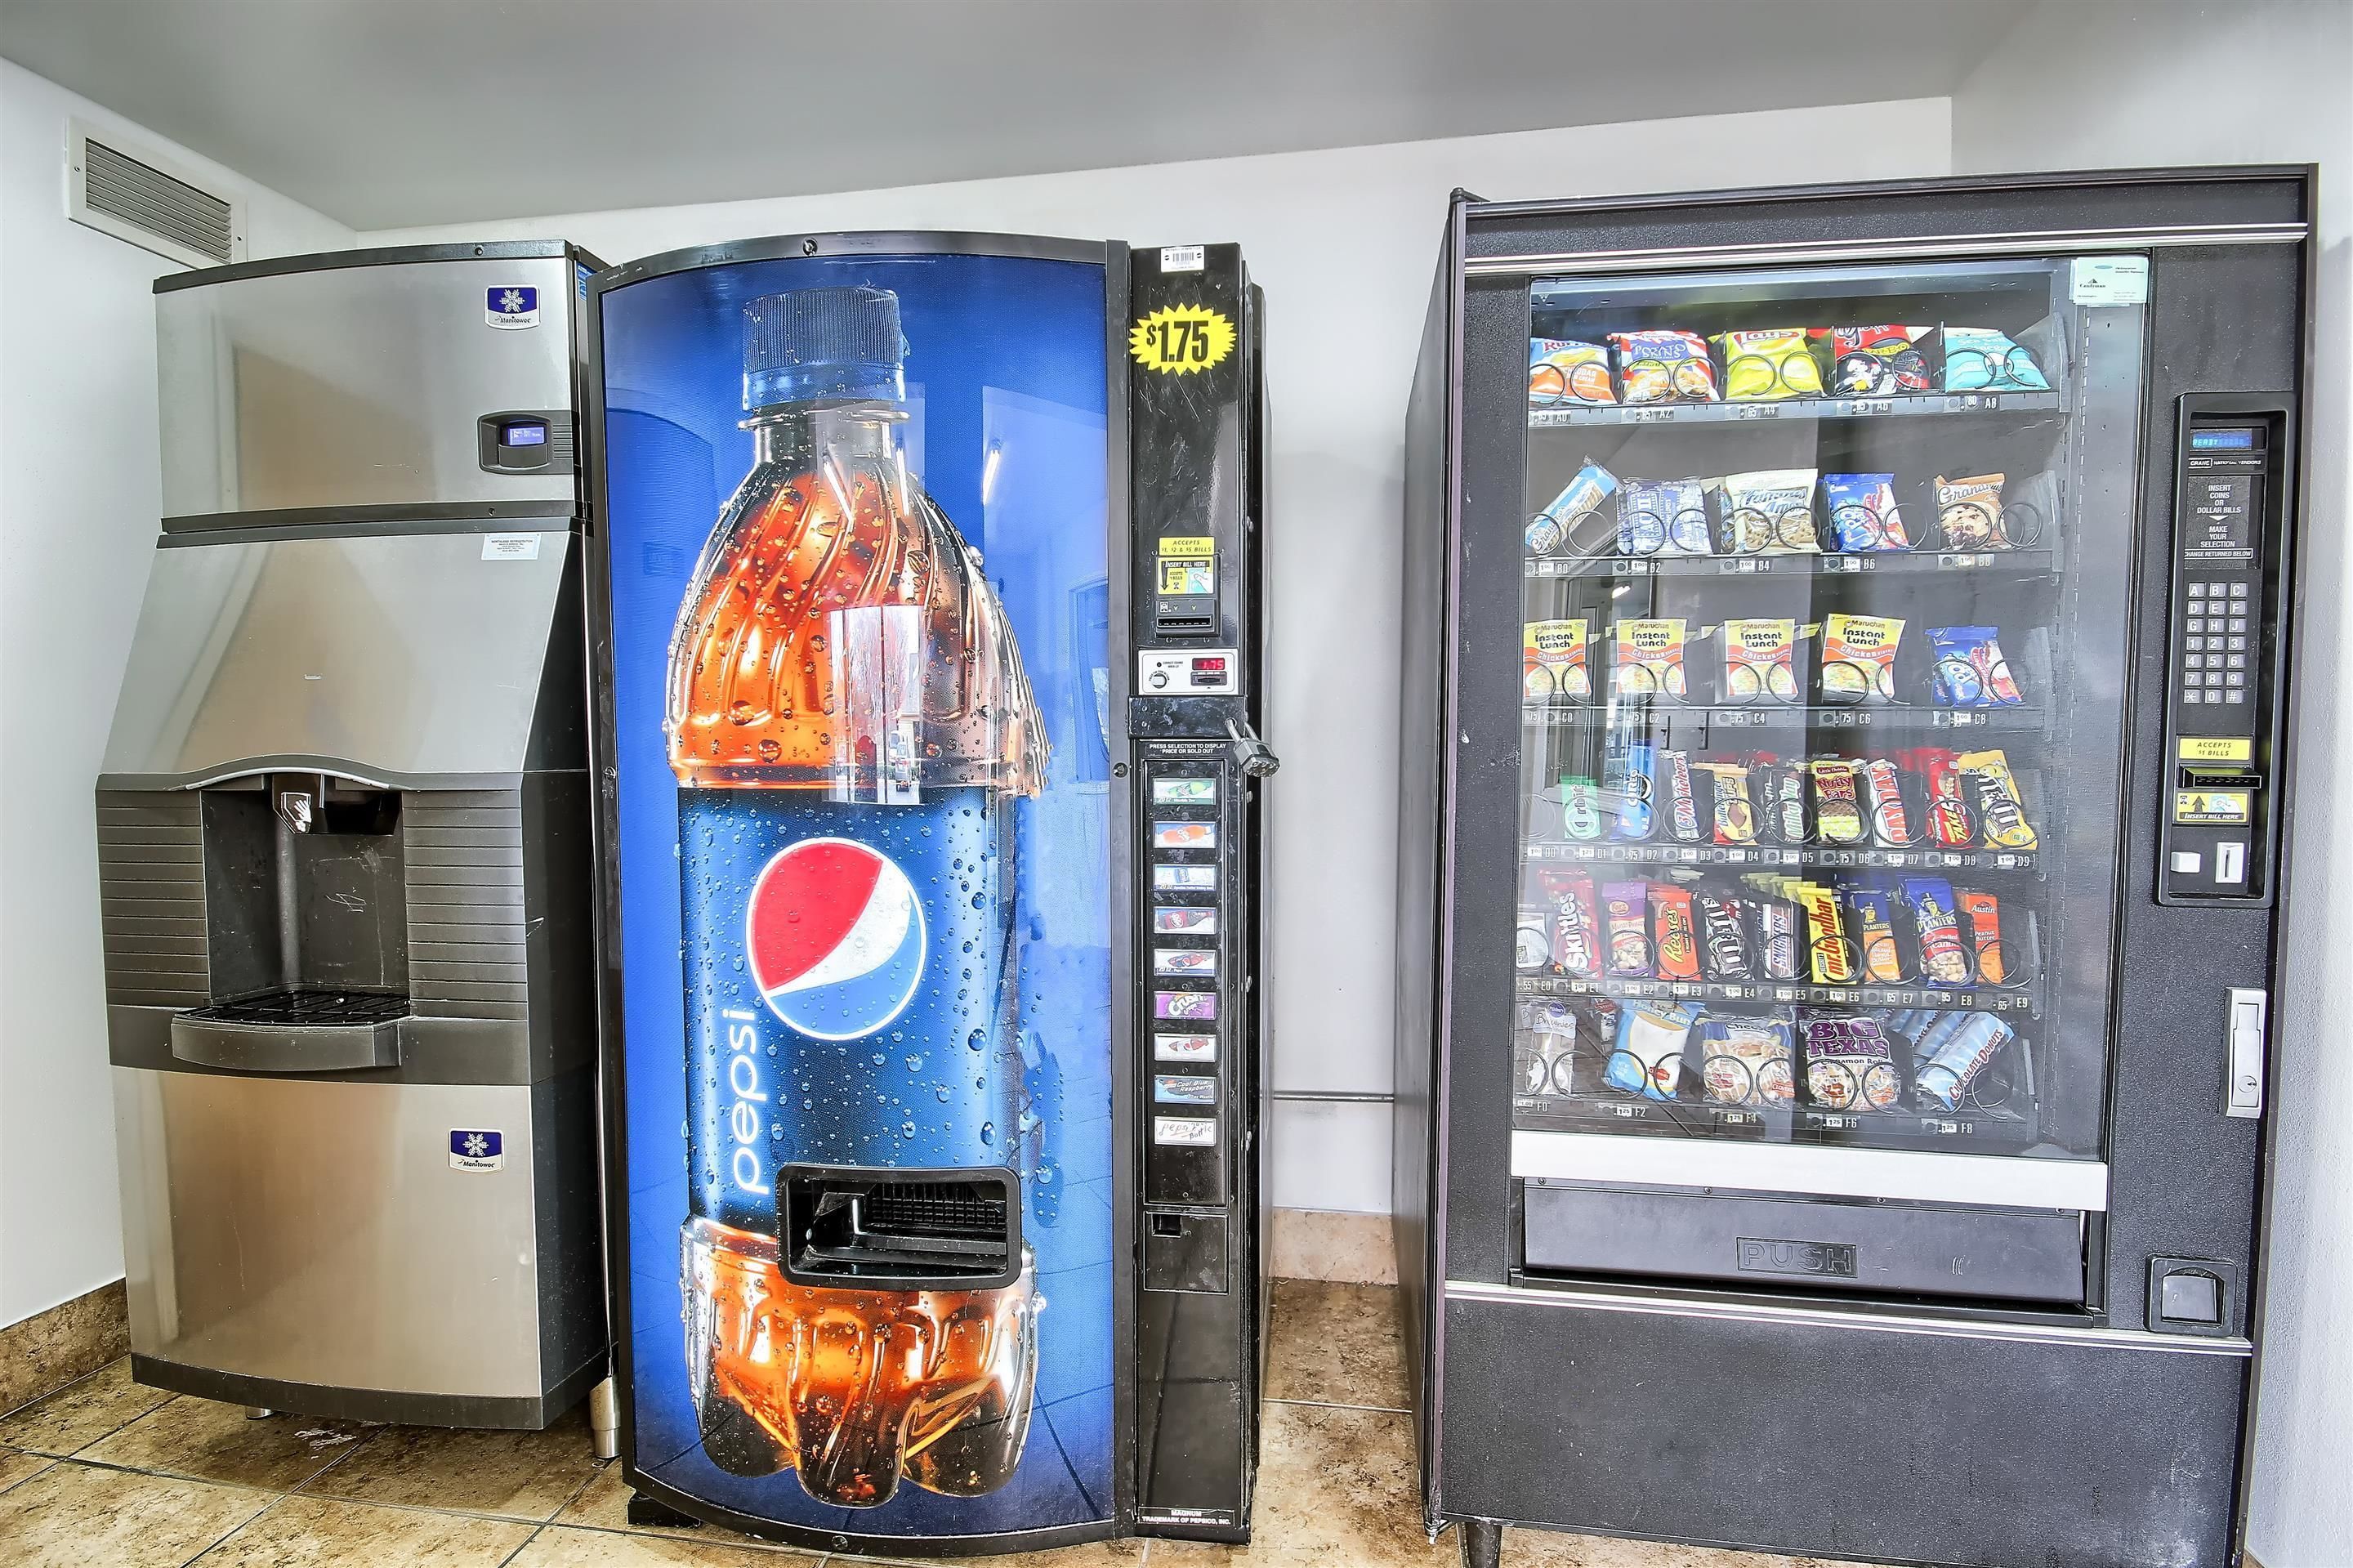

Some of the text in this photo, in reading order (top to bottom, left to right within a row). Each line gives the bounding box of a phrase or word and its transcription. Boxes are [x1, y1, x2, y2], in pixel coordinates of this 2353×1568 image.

[1146, 320, 1208, 362] $1.75
[1876, 402, 1888, 411] A6
[1984, 398, 1997, 409] A8
[1659, 410, 1671, 419] A2
[1764, 406, 1775, 415] A4
[1745, 489, 1806, 505] Famous
[1557, 563, 1568, 574] B0
[1650, 563, 1661, 574] B2
[1758, 561, 1770, 571] B4
[1863, 558, 1875, 570] B6
[2190, 587, 2198, 595] A
[2212, 587, 2219, 595] B
[2233, 587, 2240, 595] C
[2190, 604, 2198, 613] D
[2212, 604, 2218, 613] E
[2233, 604, 2239, 613] F
[1851, 619, 1886, 628] Maruchan
[2190, 621, 2197, 630] G
[2211, 621, 2218, 630] H
[2232, 621, 2239, 630] J
[1535, 632, 1574, 641] Instant
[1632, 632, 1670, 641] Instant
[1740, 632, 1782, 641] Instant
[1843, 628, 1886, 639] Instant
[1540, 640, 1570, 649] Lunch
[1636, 638, 1667, 647] Lunch
[1746, 639, 1779, 648] Lunch
[1846, 637, 1880, 646] Lunch
[2189, 639, 2195, 648] 1
[2210, 639, 2217, 648] 2
[2231, 639, 2238, 648] 3
[1537, 651, 1570, 661] Chicken
[1632, 648, 1666, 660] Chicken
[1742, 650, 1775, 661] Chicken
[1839, 645, 1876, 658] Chicken
[1203, 660, 1224, 670] 1.75
[2188, 657, 2195, 666] 4
[2209, 657, 2217, 666] 5
[2230, 657, 2237, 666] 6
[2189, 675, 2194, 683] 7
[2209, 675, 2216, 683] 8
[2230, 675, 2237, 683] 9
[2208, 692, 2216, 701] 0
[1649, 713, 1660, 723] C2
[1754, 713, 1765, 723] C4
[1859, 713, 1871, 725] C6
[1975, 713, 1986, 725] C8
[1817, 776, 1852, 788] Nutty
[1824, 788, 1855, 800] Bars
[1870, 767, 1907, 843] PAYDAY
[1782, 801, 1804, 840] Milky
[1646, 851, 1657, 860] D2
[1700, 851, 1711, 860] D3
[1748, 851, 1759, 861] D4
[1802, 853, 1813, 863] D5
[1858, 854, 1869, 864] D6
[1908, 854, 1918, 864] D7
[1964, 855, 1976, 865] D8
[2017, 856, 2029, 868] D9
[1971, 905, 1995, 914] Austin
[1917, 914, 1957, 932] PLANTERS
[1557, 892, 1588, 968] Skittles
[1773, 914, 1787, 967] SNICKERS
[1541, 981, 1551, 991] E0
[1643, 985, 1654, 994] E2
[1744, 988, 1755, 998] E4
[1795, 990, 1806, 1000] E5
[1849, 991, 1860, 1002] E6
[1903, 994, 1913, 1003] E7
[1961, 995, 1972, 1006] E8
[2016, 997, 2028, 1007] E9
[1168, 994, 1206, 1016] Crush
[1669, 1012, 1691, 1025] Bun
[1809, 1020, 1880, 1039] BIG
[1806, 1039, 1889, 1058] TEXAS
[1979, 1028, 2003, 1064] DONUTS
[1179, 1084, 1213, 1092] Raspberry
[722, 1008, 769, 1195] pepsi
[1537, 1102, 1547, 1112] F0
[1635, 1107, 1646, 1117] F2
[1846, 1118, 1857, 1128] F6
[1961, 1124, 1972, 1134] F8
[1744, 1243, 1851, 1273] PUSH
